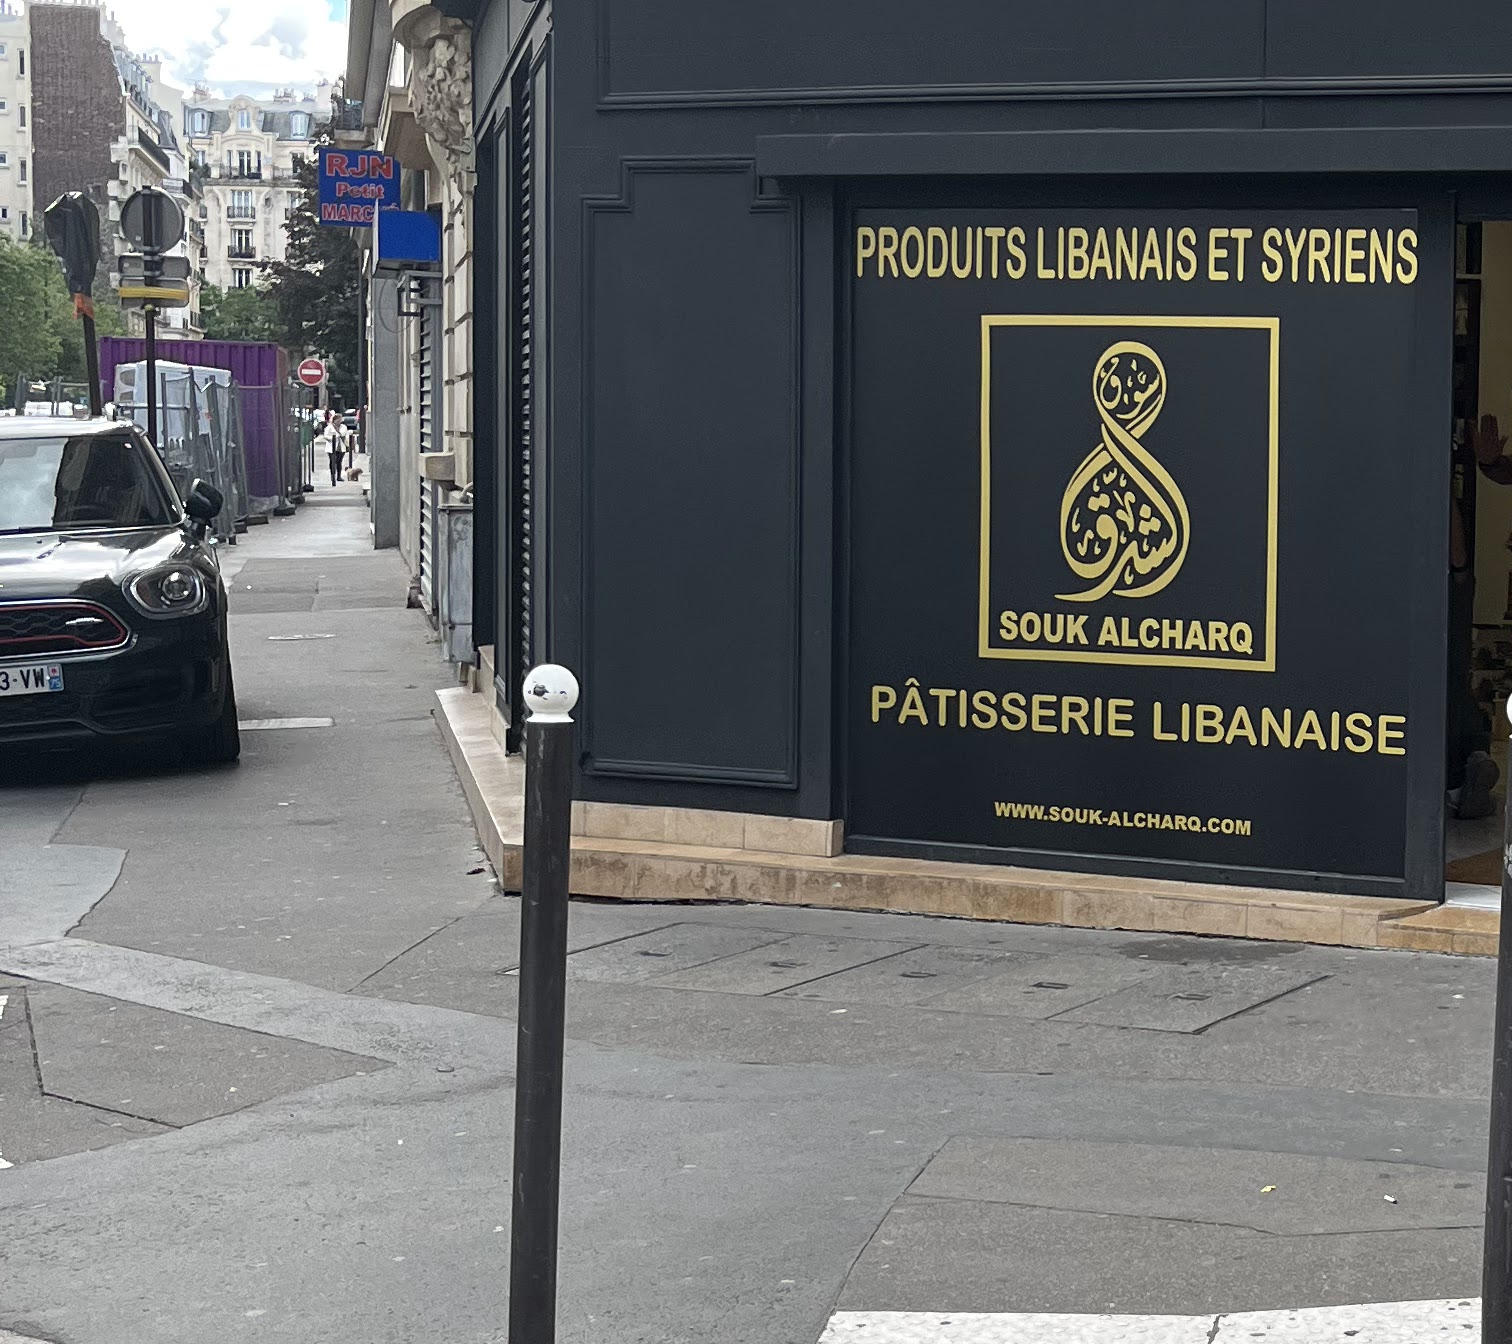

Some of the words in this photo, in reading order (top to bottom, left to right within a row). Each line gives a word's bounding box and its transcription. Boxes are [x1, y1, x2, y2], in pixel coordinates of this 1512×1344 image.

[326, 153, 393, 179] RJN
[336, 182, 385, 199] Petit
[322, 203, 398, 223] MARC
[857, 227, 1027, 280] PRODUITS
[1037, 228, 1198, 282] LIBANAIS
[1208, 229, 1253, 282] ET
[1261, 228, 1418, 285] SYRIENS
[999, 611, 1089, 646] SOUK
[1097, 617, 1254, 655] ALCHARQ
[870, 677, 1134, 738] PÂTISSERIE
[1152, 702, 1407, 756] LIBANAISE
[994, 802, 1252, 836] WWW.SOUK-ALCHARQ.COM
